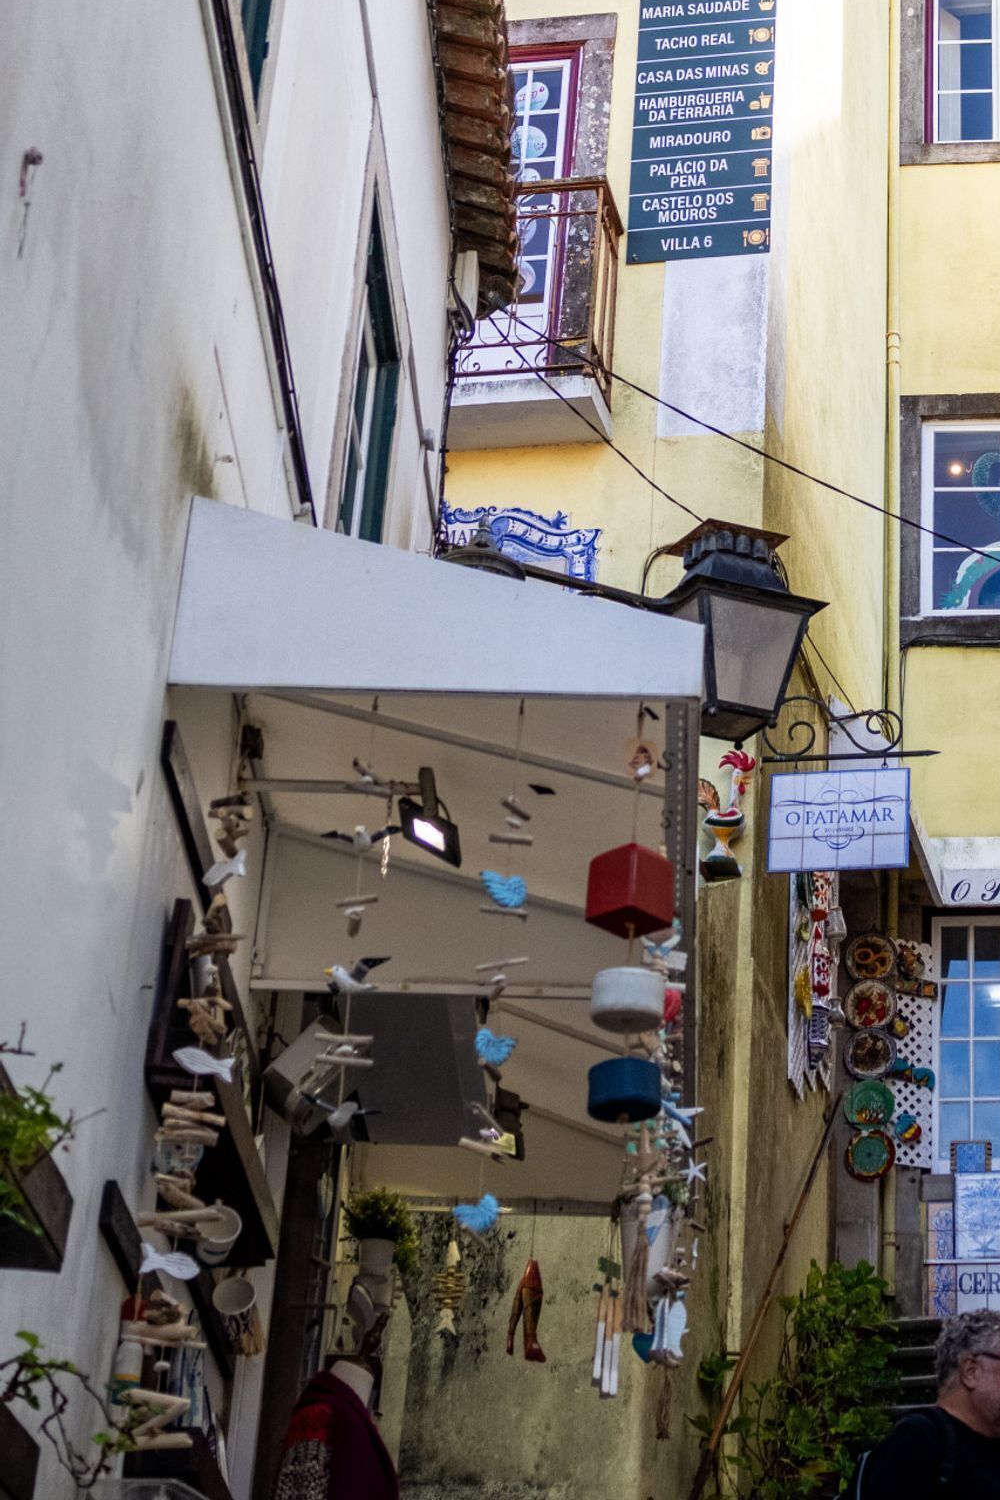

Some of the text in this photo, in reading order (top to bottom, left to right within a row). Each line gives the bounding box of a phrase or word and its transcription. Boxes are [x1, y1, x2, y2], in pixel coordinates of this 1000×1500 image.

[642, 0, 750, 19] MARIA SAUDADE
[655, 32, 735, 50] TACHO REAL
[637, 63, 750, 84] CASA DAS MINAS
[639, 90, 745, 110] HAMBURGUERIA
[648, 104, 734, 122] DA FERRARIA
[649, 130, 731, 149] MIRADOURO
[649, 159, 728, 177] PALÁCIO DA
[670, 174, 706, 188] PENA
[642, 192, 734, 211] CASTELO DOS
[658, 207, 717, 223] MOUROS
[661, 235, 712, 251] VILLA 6
[785, 807, 895, 826] O PATAMAR
[950, 878, 971, 902] O
